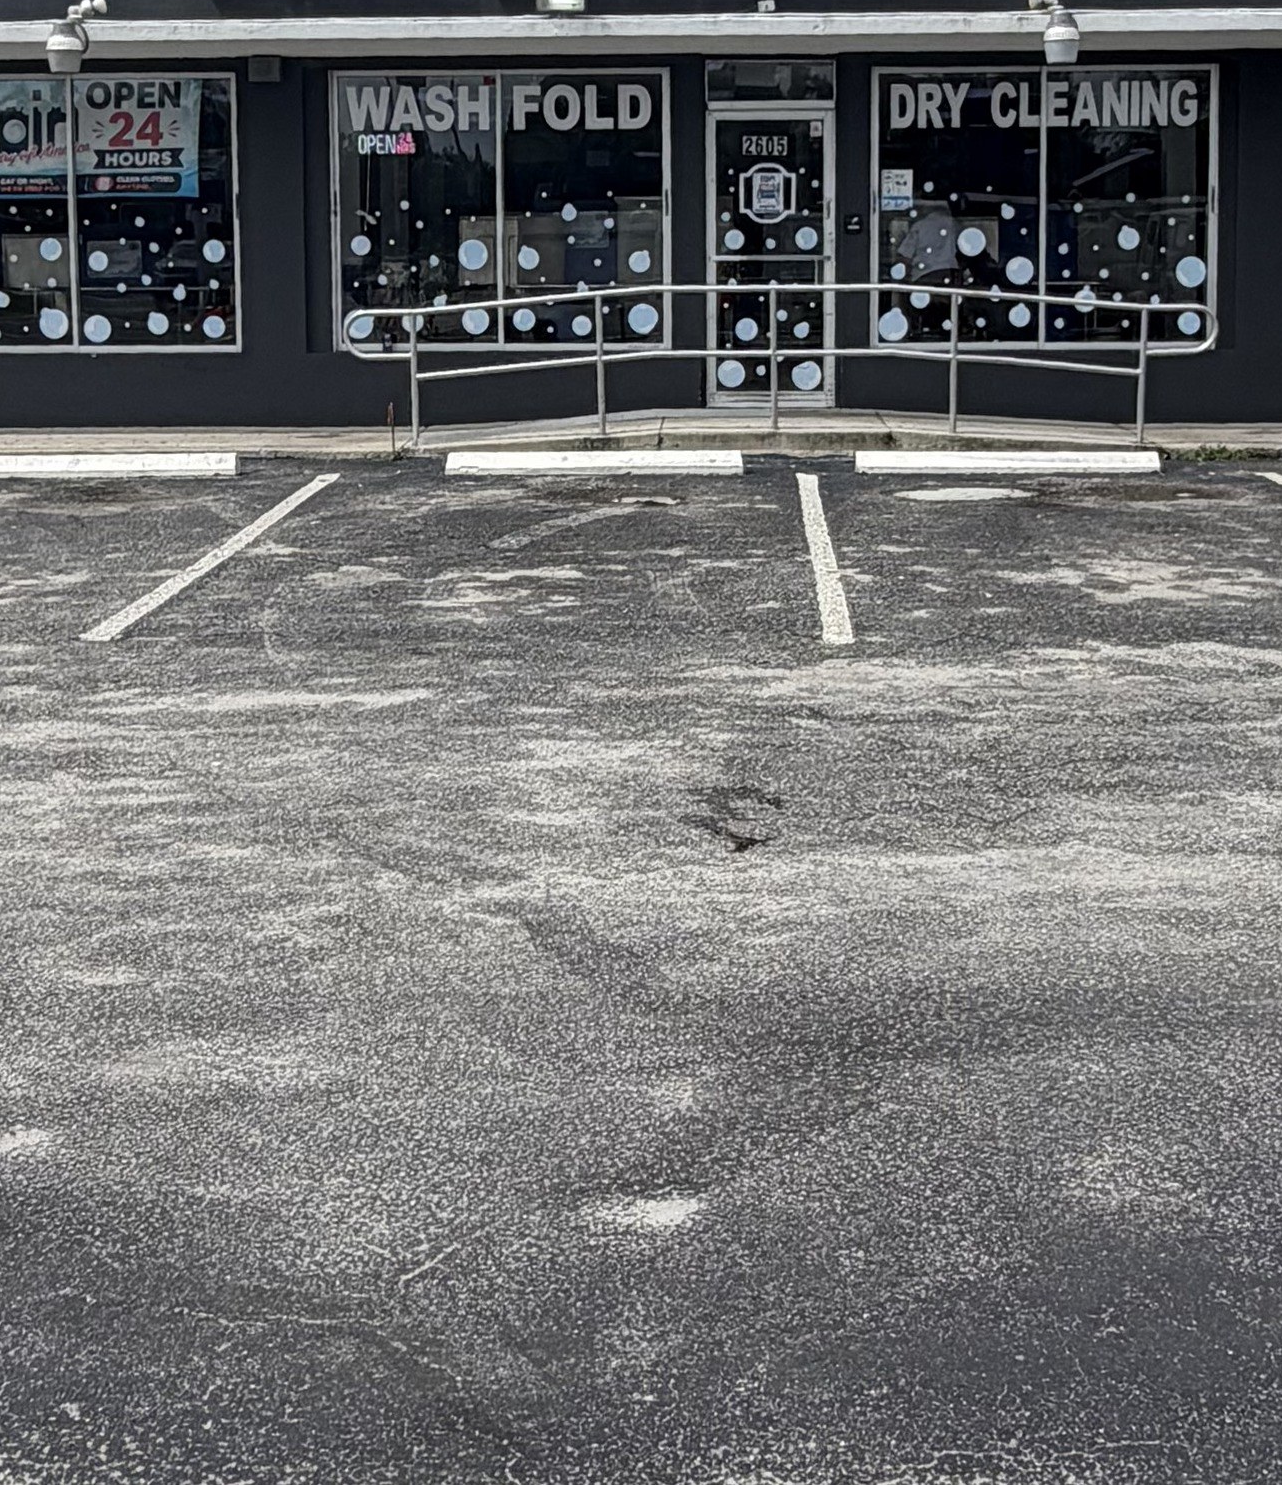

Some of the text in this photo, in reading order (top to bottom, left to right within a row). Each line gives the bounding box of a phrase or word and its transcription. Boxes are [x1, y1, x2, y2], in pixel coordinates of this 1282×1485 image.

[85, 81, 182, 110] OPEN
[346, 84, 653, 132] WASH FOLD
[890, 80, 1198, 129] DRY CLEANING
[108, 111, 164, 148] 24
[105, 151, 173, 167] HOURS
[358, 134, 396, 155] OPEN
[743, 137, 786, 155] 2605
